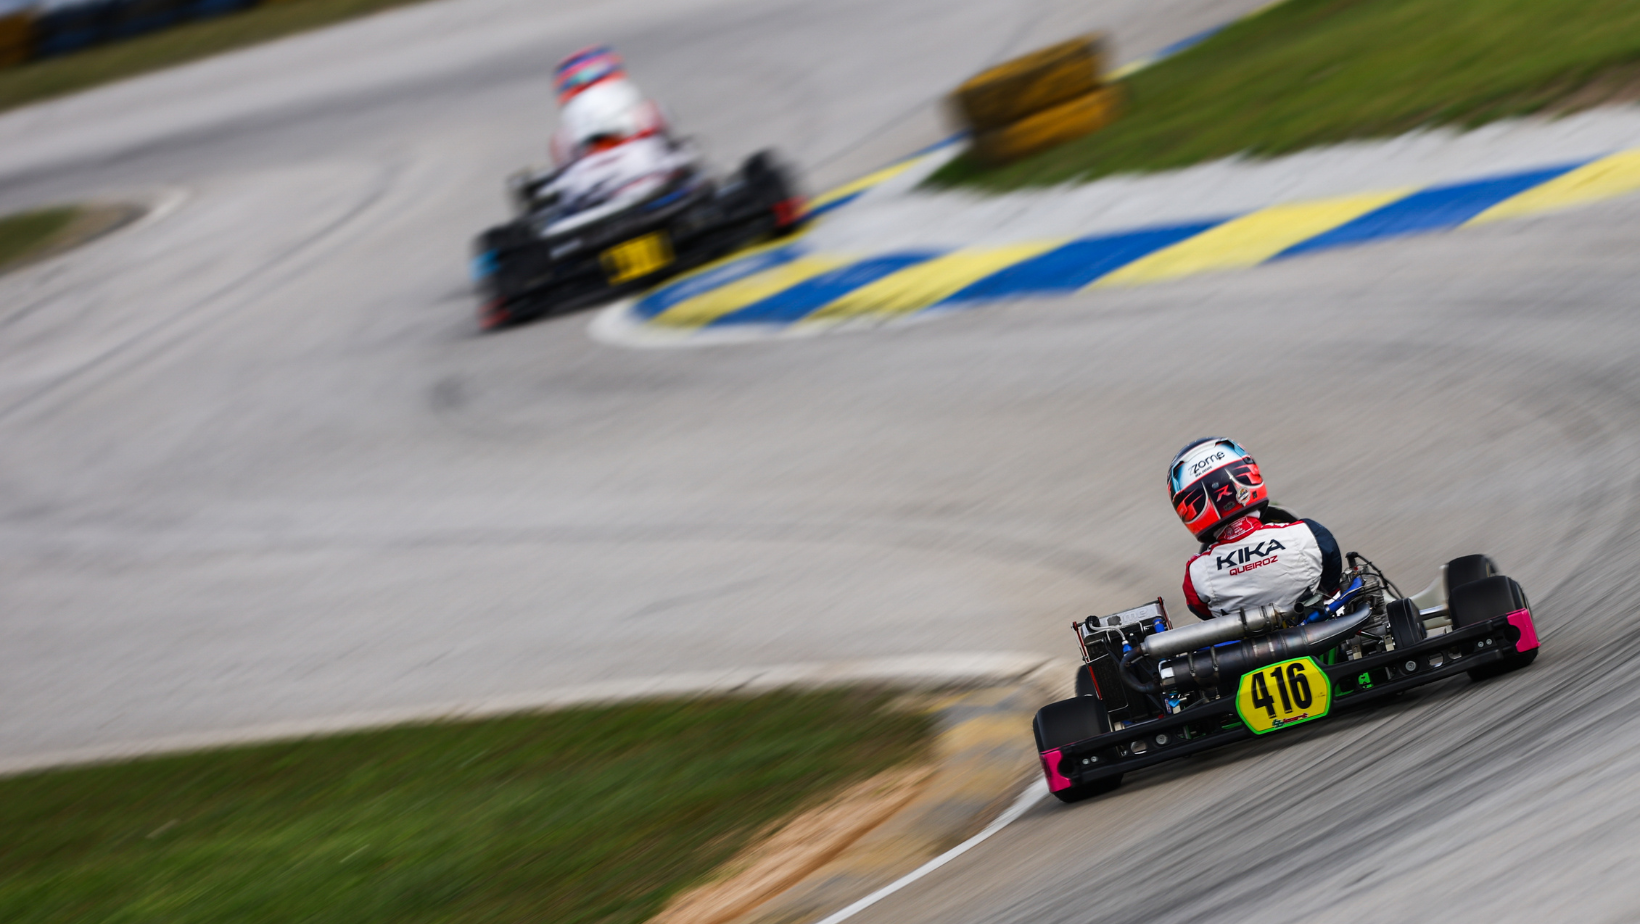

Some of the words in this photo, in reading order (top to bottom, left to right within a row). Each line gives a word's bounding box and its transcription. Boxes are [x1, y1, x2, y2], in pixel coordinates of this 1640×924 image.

[1216, 538, 1286, 571] KIKA
[1229, 555, 1279, 576] QUEIROZ
[1250, 662, 1313, 719] 416
